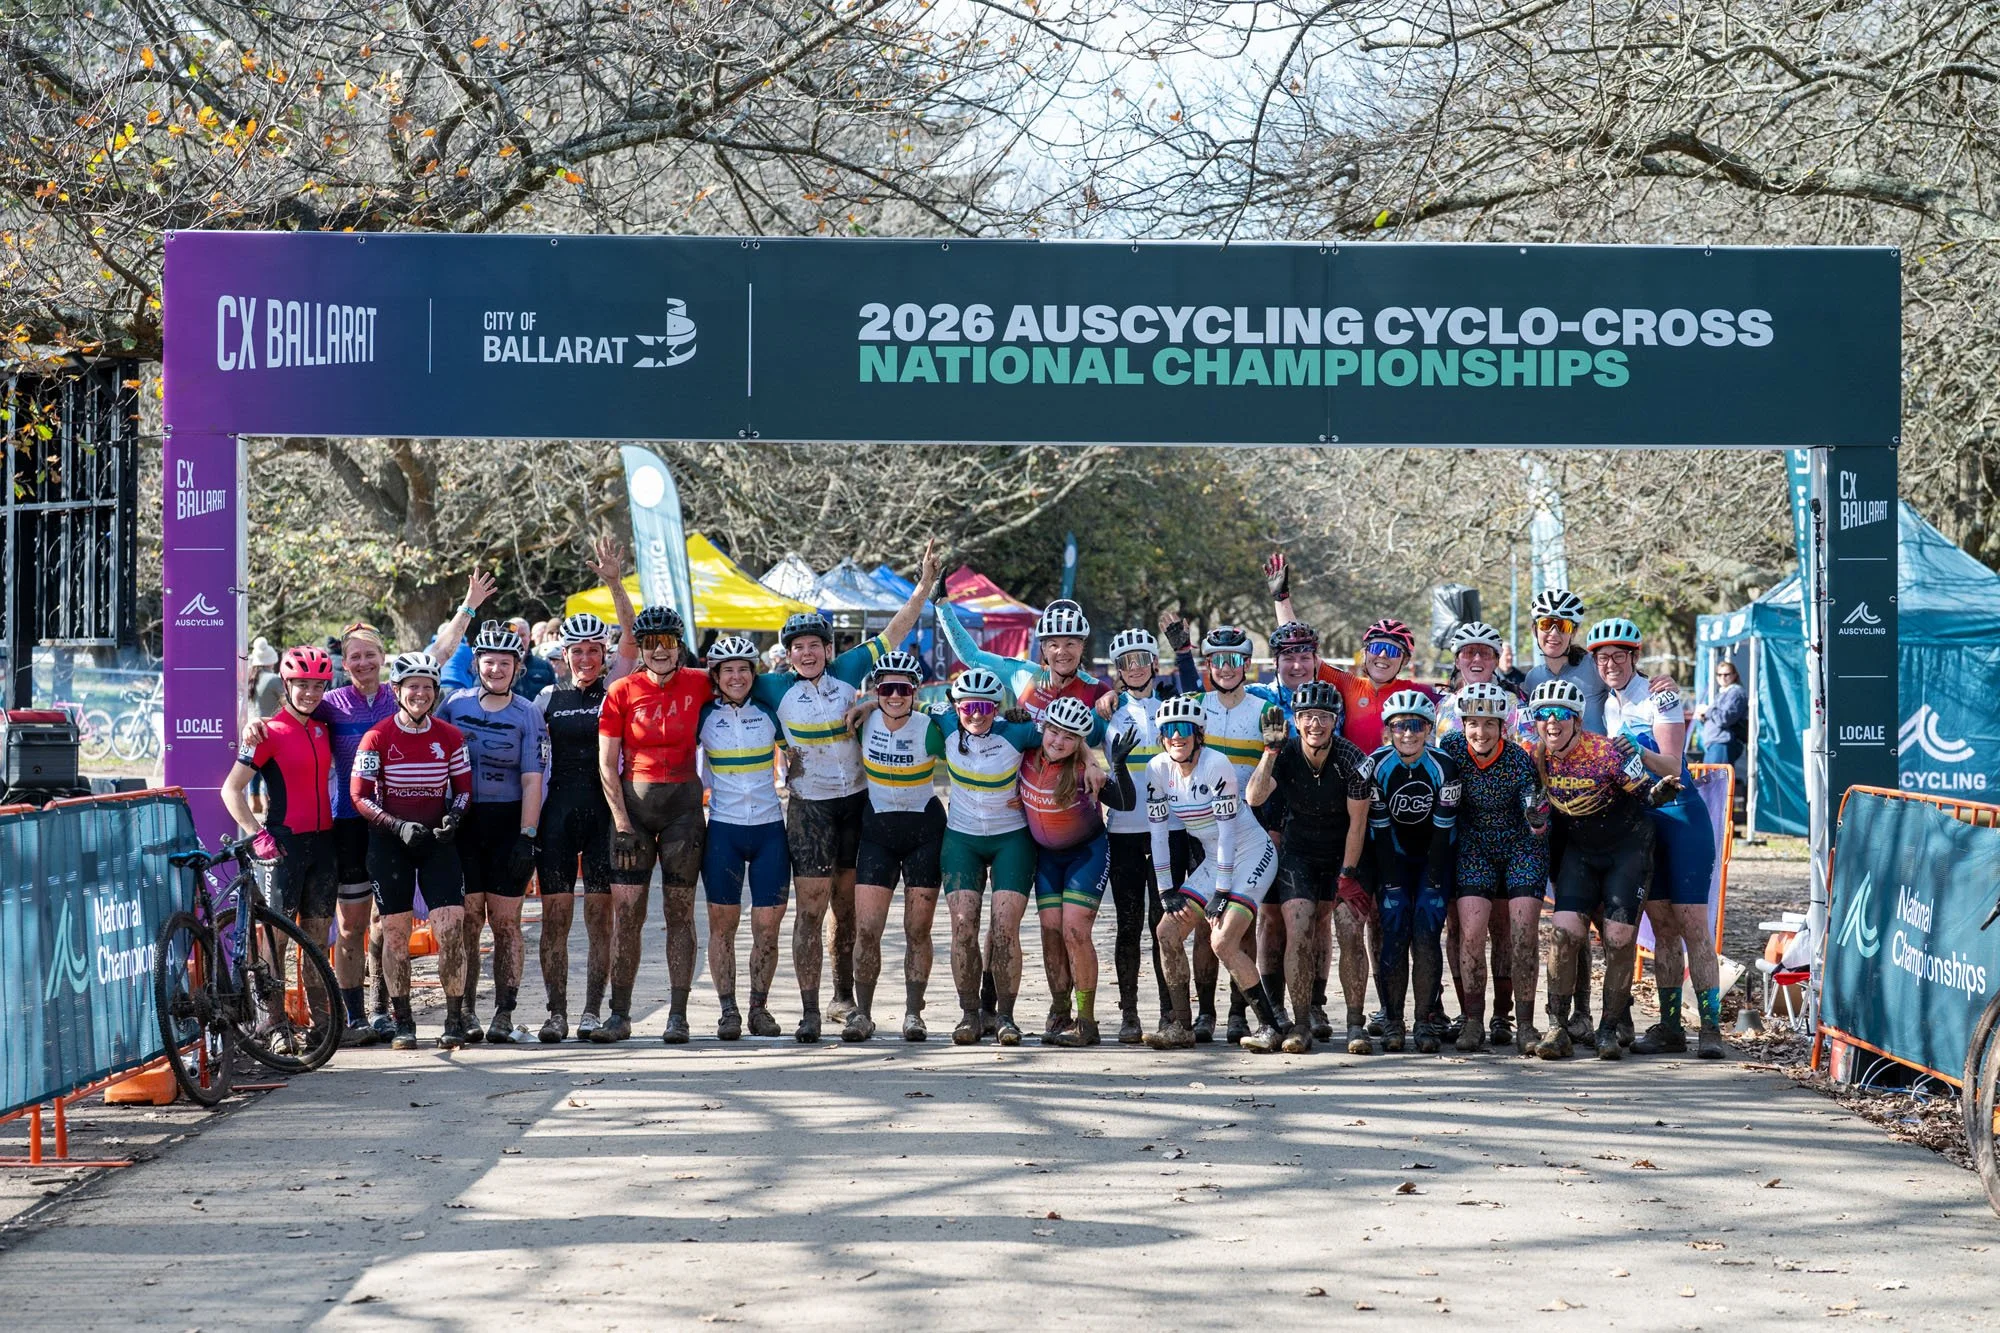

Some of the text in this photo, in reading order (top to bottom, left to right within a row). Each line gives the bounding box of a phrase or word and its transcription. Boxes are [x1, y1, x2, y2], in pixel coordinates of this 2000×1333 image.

[483, 311, 537, 331] CITY OF
[857, 303, 1775, 347] 2026 AUSCYCLING CYCLO-CROSS
[217, 295, 377, 371] CX BALLARAT
[483, 335, 629, 364] BALLARAT
[859, 345, 1630, 388] NATIONAL CHAMPIONSHIPS
[176, 458, 194, 489] CX
[1840, 470, 1857, 500] CX
[176, 489, 227, 521] BALLARAT
[1840, 500, 1888, 531] BALLARAT
[175, 619, 225, 627] AUSCYCLING
[1838, 627, 1886, 636] AUSCYCLING
[1656, 690, 1675, 706] 219
[553, 704, 600, 718] cervé
[633, 696, 693, 722] MAAP
[1523, 709, 1535, 721] 11
[176, 718, 224, 734] LOCALE
[1839, 725, 1886, 740] LOCALE
[359, 757, 377, 770] 155
[880, 752, 914, 764] ENZED
[1899, 771, 1987, 791] CYCLING
[1149, 803, 1167, 817] 210
[1215, 801, 1234, 814] 210
[94, 888, 142, 936] National
[1896, 884, 1935, 934] National
[1891, 929, 1987, 1001] Championships
